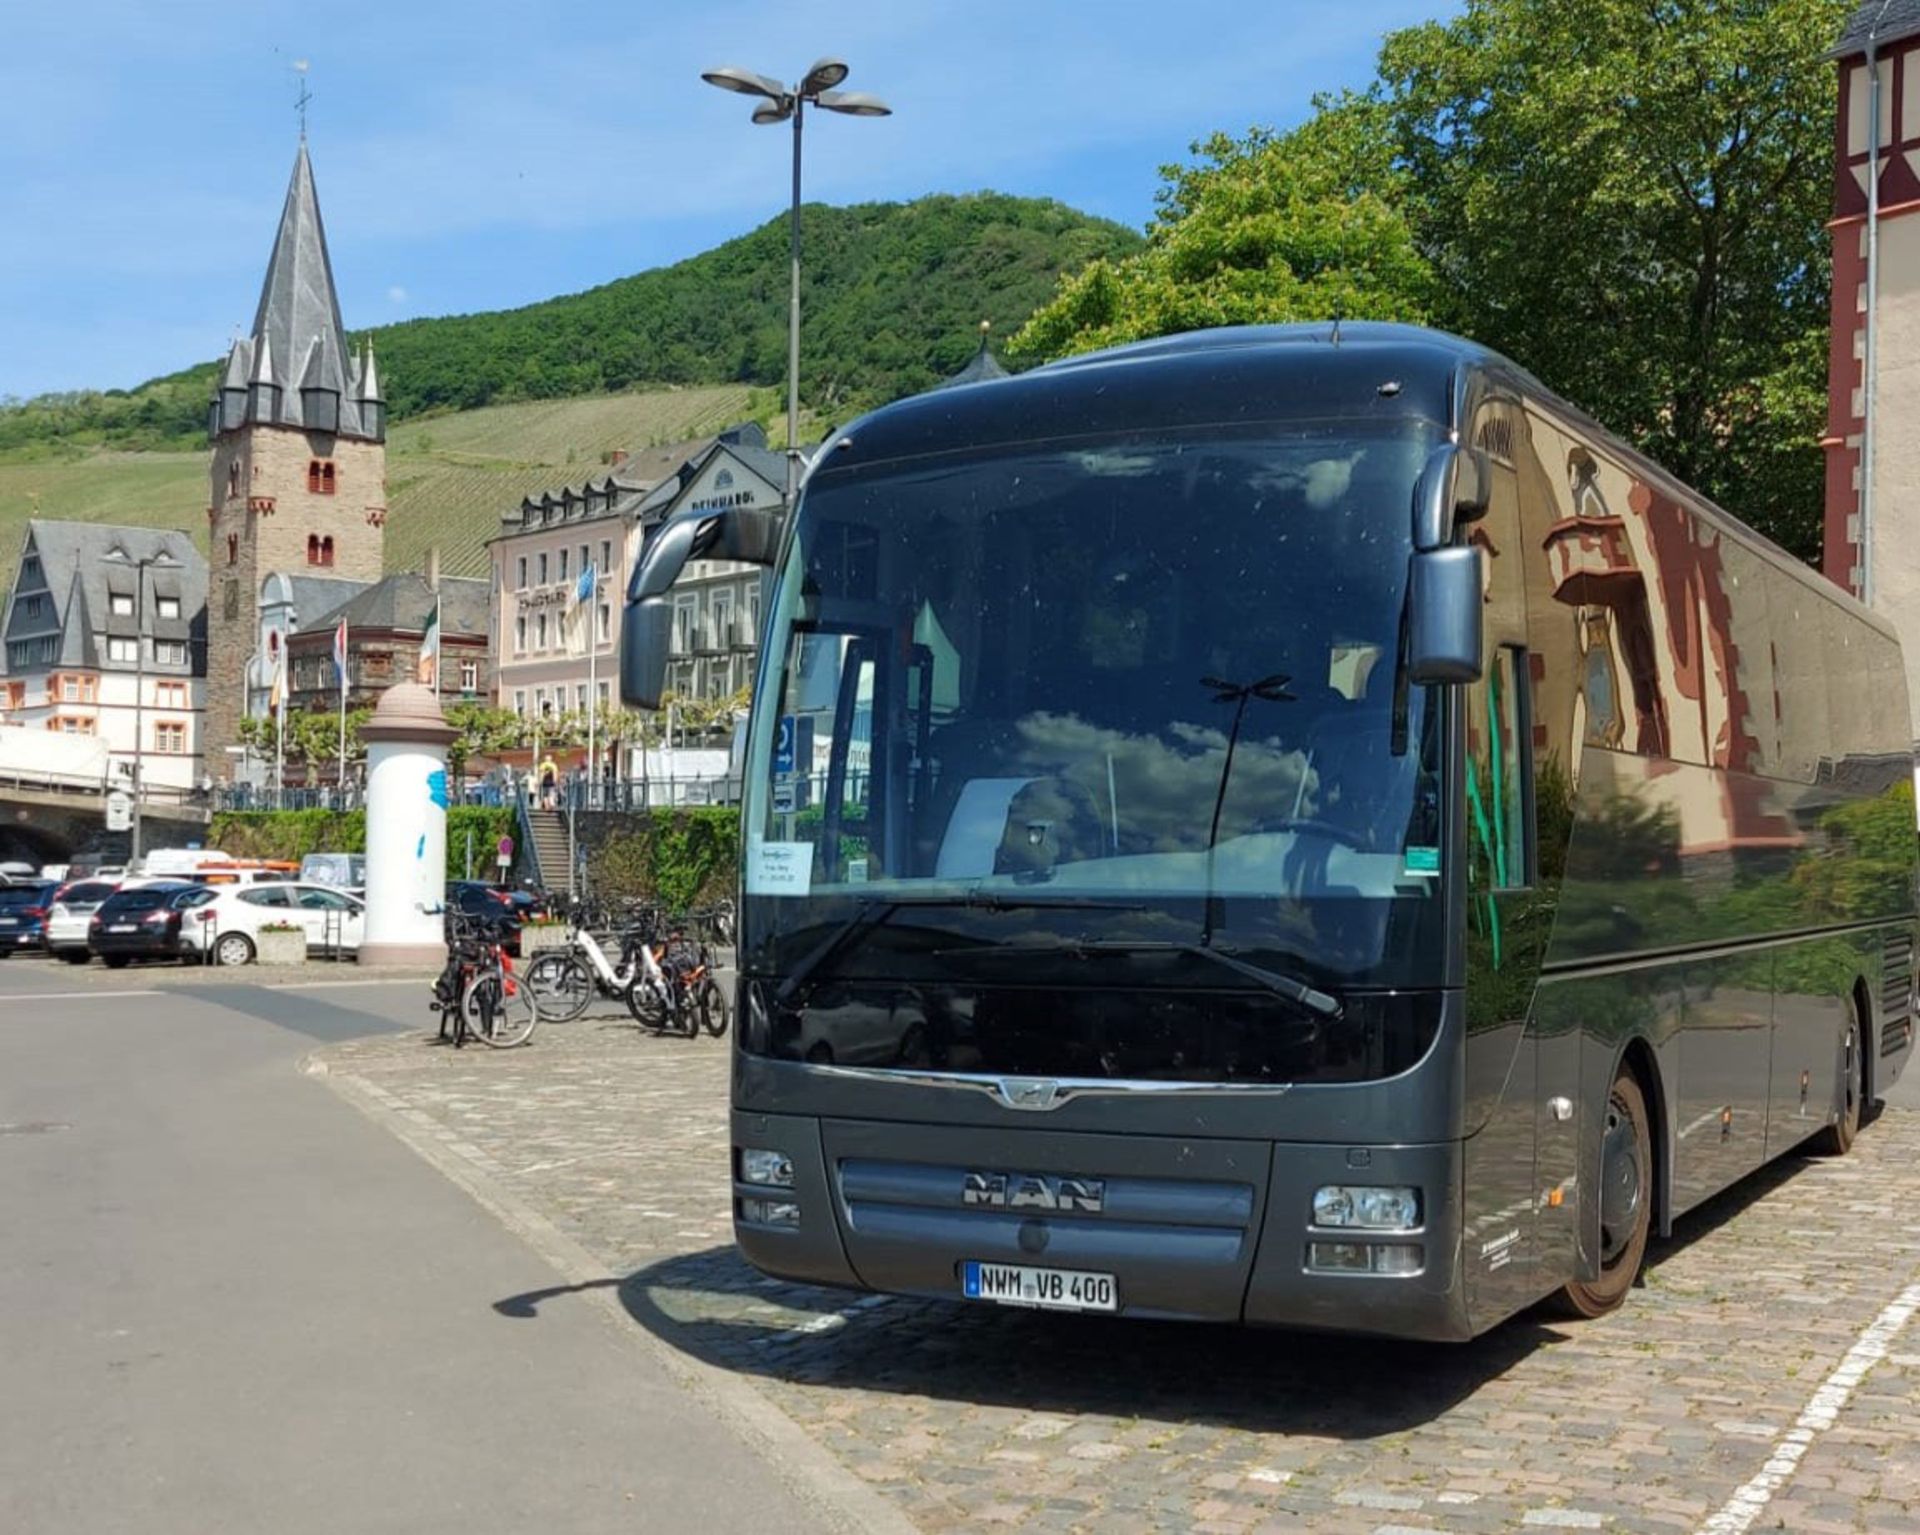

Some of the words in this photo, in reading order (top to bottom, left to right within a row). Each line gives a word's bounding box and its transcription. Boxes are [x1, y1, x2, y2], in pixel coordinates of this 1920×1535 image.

[963, 1173, 1105, 1212] MAN
[981, 1268, 1021, 1297] NWM
[1036, 1272, 1064, 1300] VB
[1070, 1276, 1111, 1305] 400
